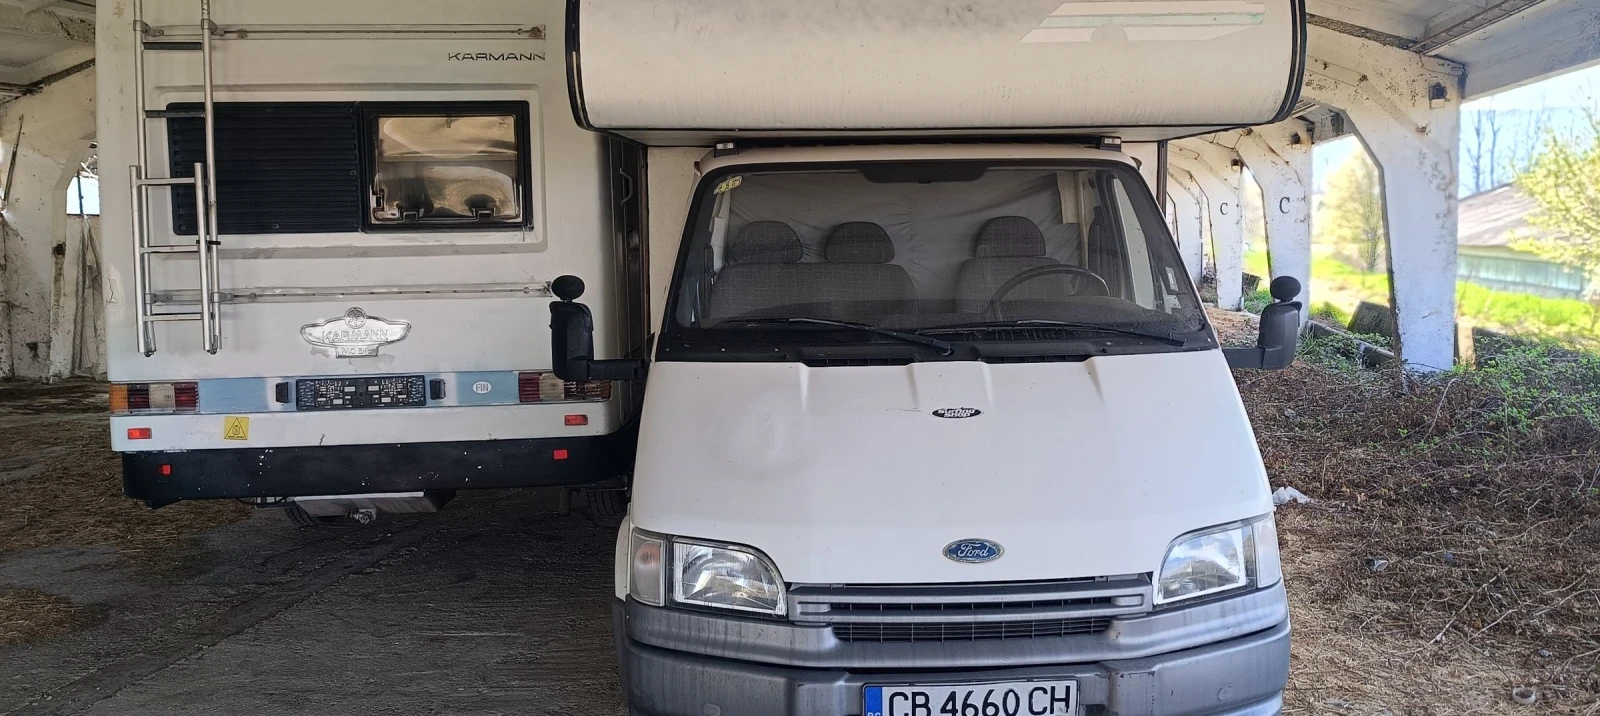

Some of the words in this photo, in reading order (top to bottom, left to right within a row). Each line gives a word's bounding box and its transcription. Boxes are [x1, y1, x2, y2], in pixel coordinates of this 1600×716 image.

[448, 52, 546, 61] KARMANN
[1219, 202, 1229, 216] C
[1279, 196, 1291, 214] C
[322, 329, 389, 343] KARMANN
[475, 383, 489, 392] FIN
[957, 543, 989, 557] Ford
[888, 691, 932, 716] CB
[940, 689, 1021, 716] 4660
[1028, 685, 1071, 716] CH
